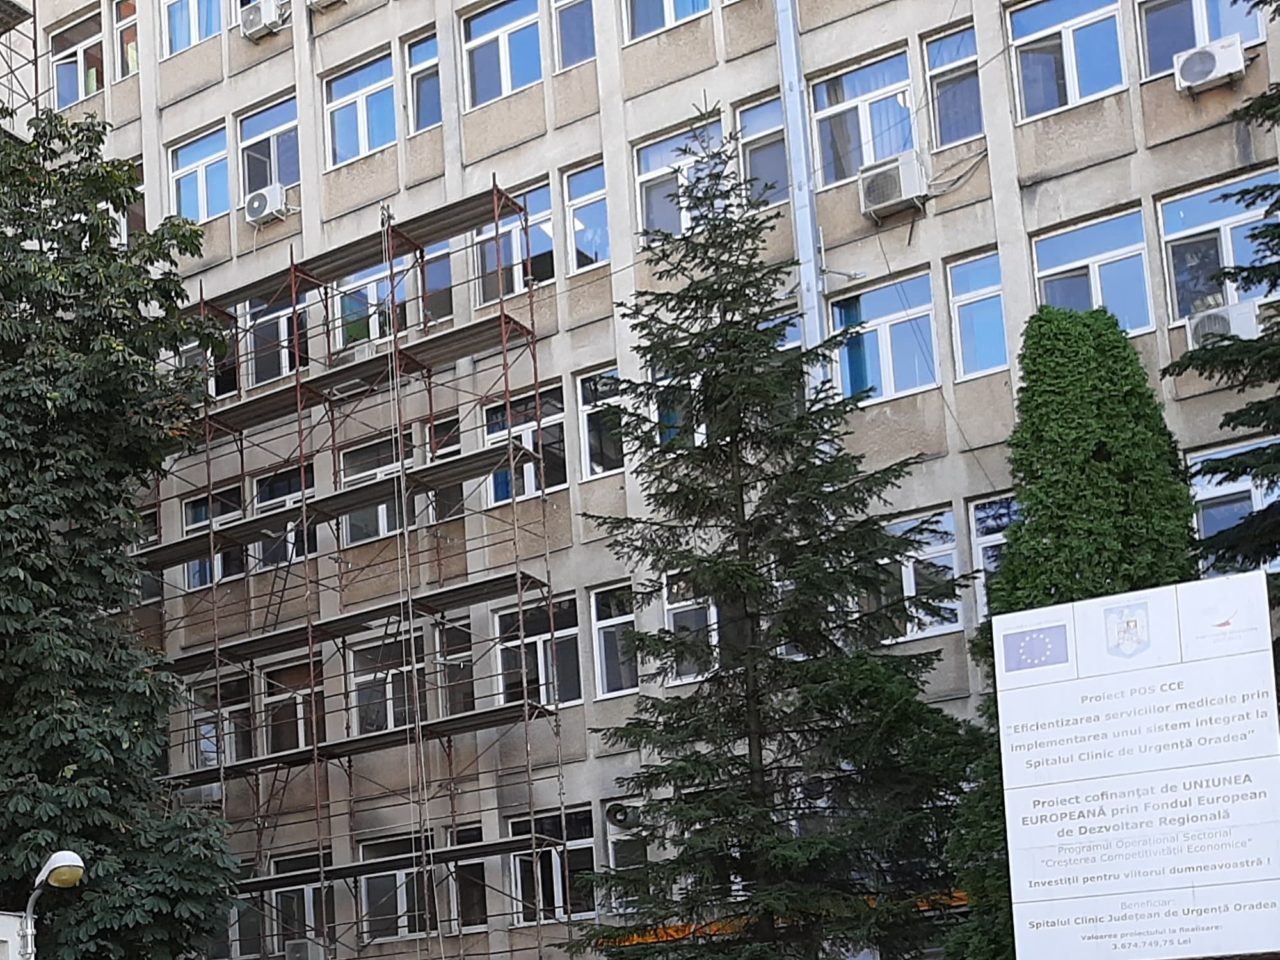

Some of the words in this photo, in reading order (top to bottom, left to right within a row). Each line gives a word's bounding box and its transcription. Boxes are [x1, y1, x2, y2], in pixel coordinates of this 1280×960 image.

[1080, 689, 1125, 704] Proiect
[1129, 685, 1156, 697] POS
[1160, 680, 1185, 693] CCE
[1104, 703, 1171, 722] serviciilor
[1175, 693, 1237, 711] medicale
[1241, 689, 1270, 704] prin
[1010, 731, 1108, 753] implementarea
[1112, 725, 1142, 739] unui
[1146, 720, 1191, 735] sistem
[1195, 711, 1252, 728] integrat
[1255, 708, 1268, 719] la
[1025, 753, 1074, 770] Spitalul
[1078, 749, 1115, 762] Clinic
[1118, 746, 1134, 757] de
[1032, 795, 1081, 809] Proiect
[1160, 783, 1178, 794] de
[1182, 773, 1253, 792] UNIUNEA
[1111, 804, 1139, 818] prin
[1143, 797, 1192, 812] Fondul
[1197, 790, 1267, 806] European
[1056, 827, 1074, 838] de
[1078, 819, 1154, 837] Dezvoltare
[1158, 809, 1231, 827] Regională
[1057, 841, 1112, 856] Programul
[1182, 828, 1232, 843] Sectorial
[1082, 871, 1121, 885] pentru
[1123, 866, 1166, 880] viitorul
[1168, 857, 1263, 875] dumneavoastră
[1028, 917, 1071, 930] Spitalul
[1073, 915, 1105, 926] Clinic
[1164, 909, 1179, 918] de
[1233, 901, 1277, 912] Oradea
[1177, 937, 1192, 946] Lei
